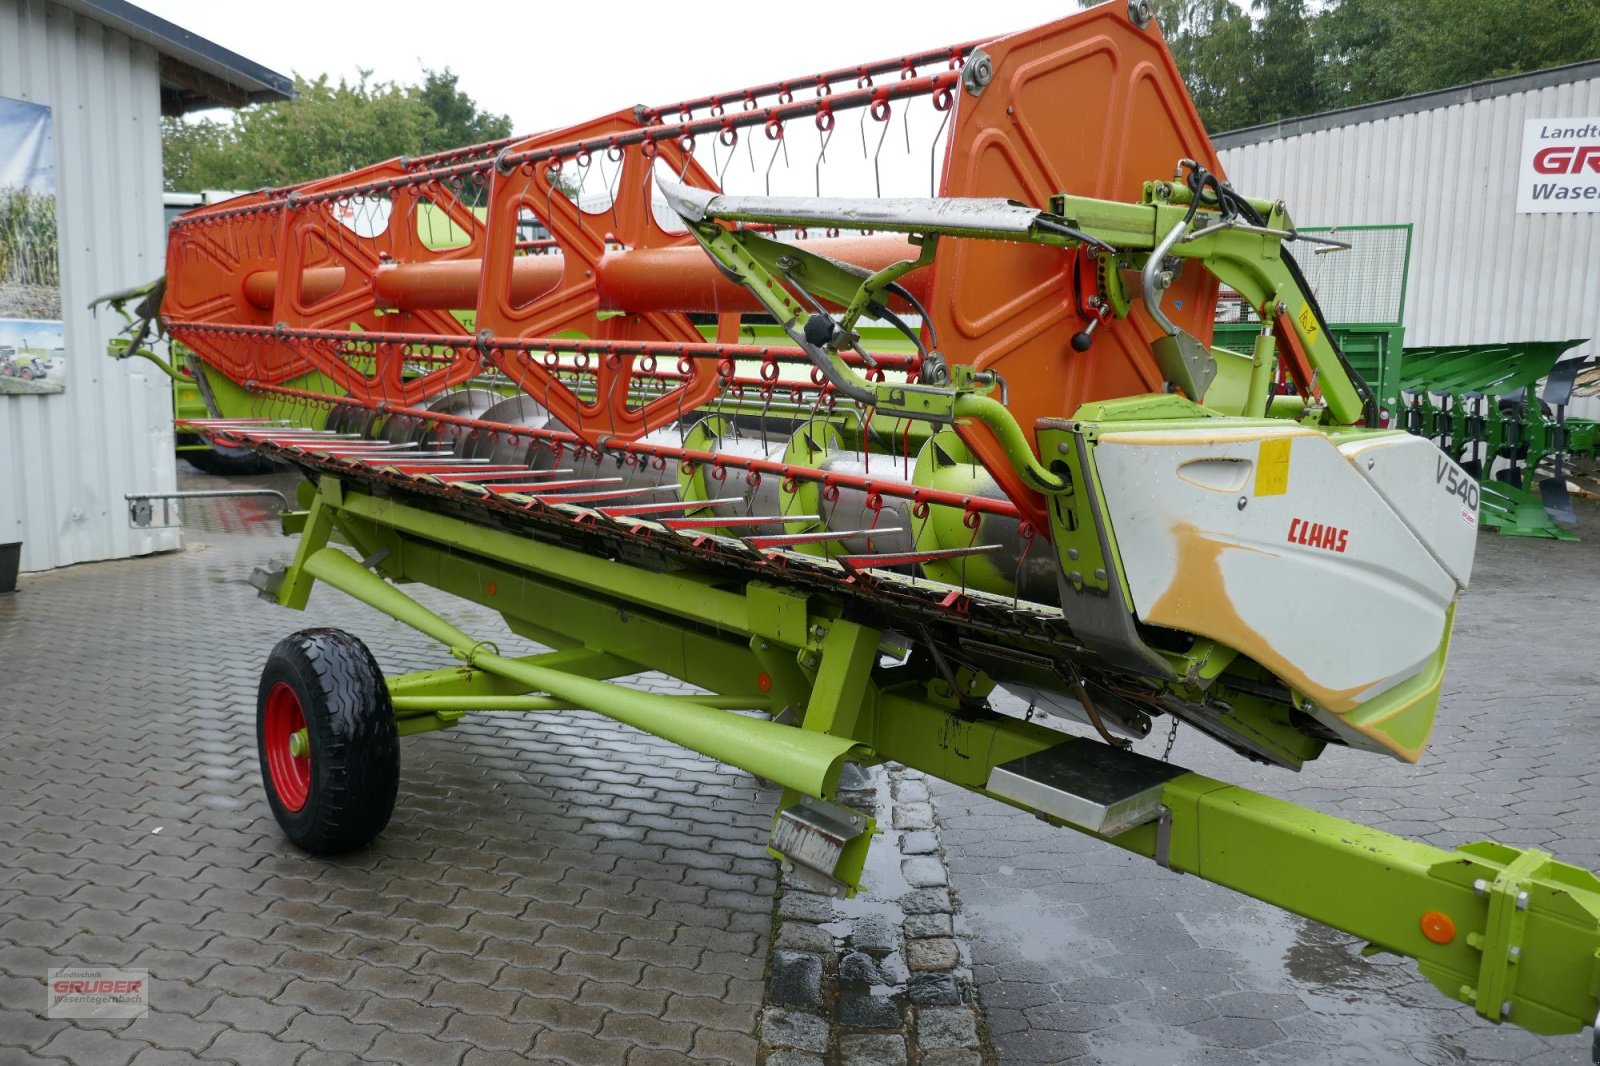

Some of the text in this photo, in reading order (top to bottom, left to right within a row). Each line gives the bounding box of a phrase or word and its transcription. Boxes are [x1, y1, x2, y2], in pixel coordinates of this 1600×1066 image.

[1540, 124, 1600, 139] Landt
[1532, 183, 1600, 200] Wase
[1287, 518, 1348, 553] CLAAS
